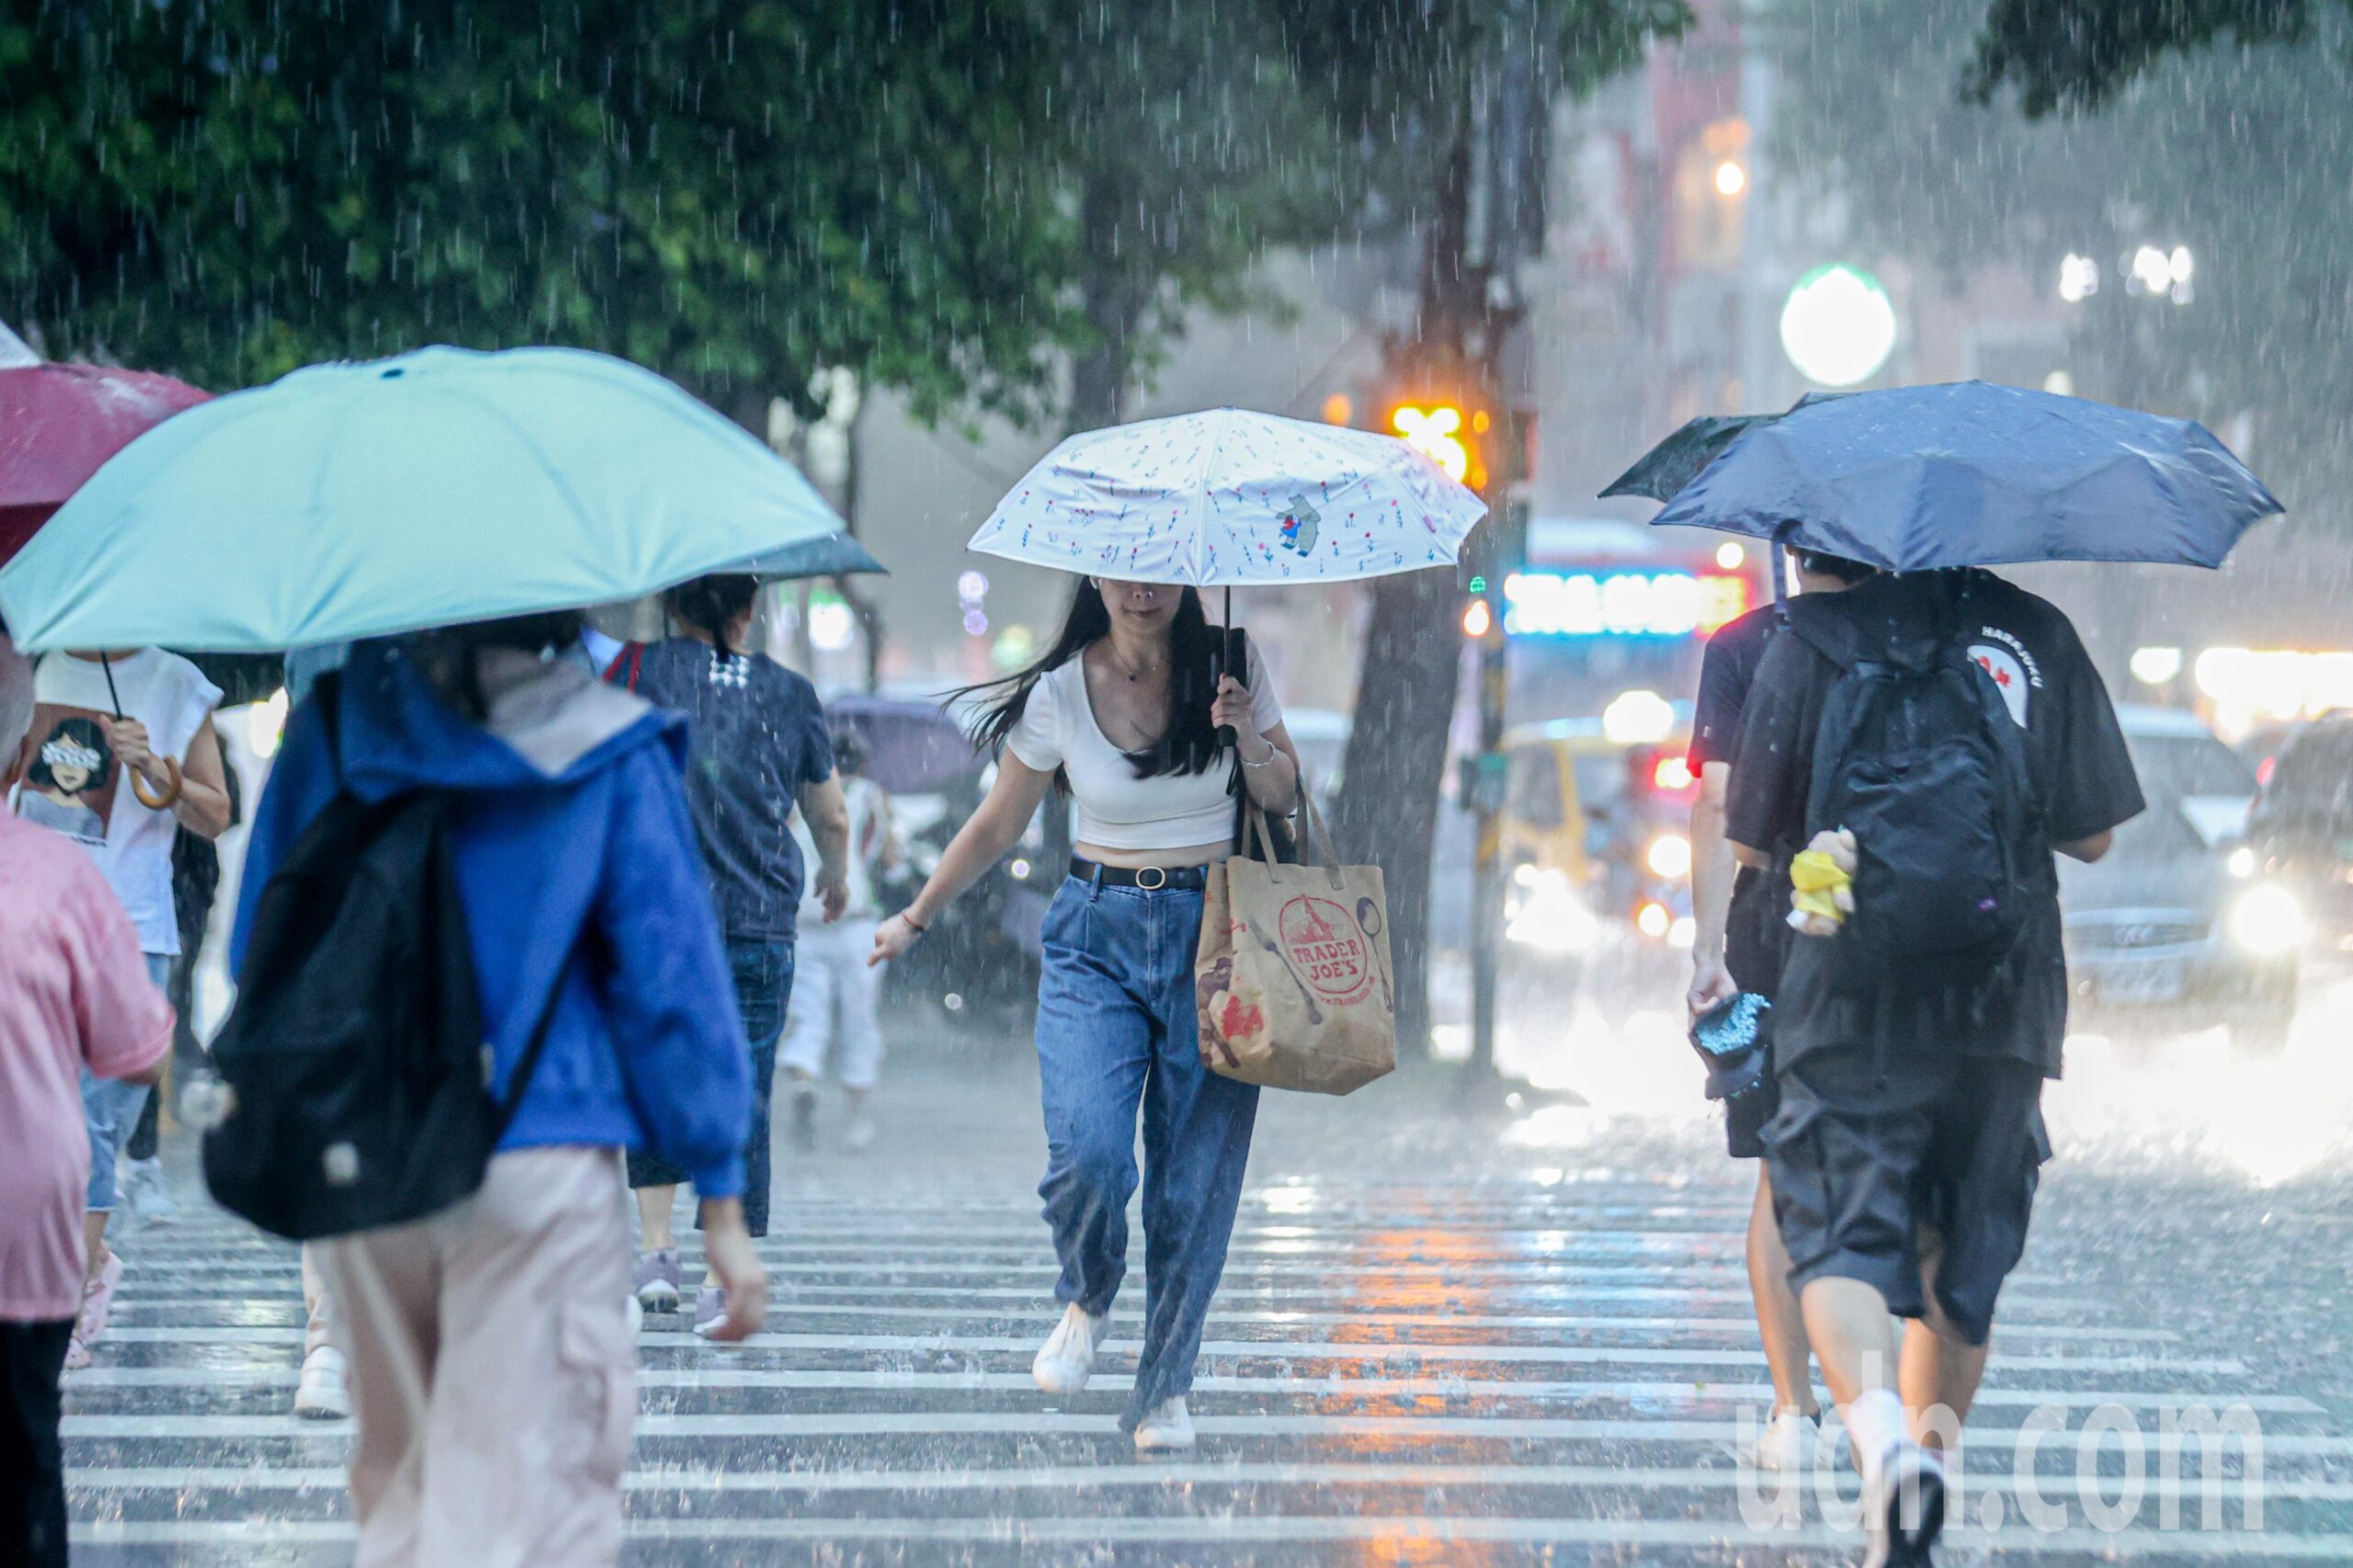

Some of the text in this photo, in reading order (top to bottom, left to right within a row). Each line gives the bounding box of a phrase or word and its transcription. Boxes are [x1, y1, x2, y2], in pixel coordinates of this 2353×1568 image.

[1982, 626, 2043, 688] HARAJUKU
[1293, 939, 1359, 963] TRADER
[1310, 960, 1358, 981] JOE'S
